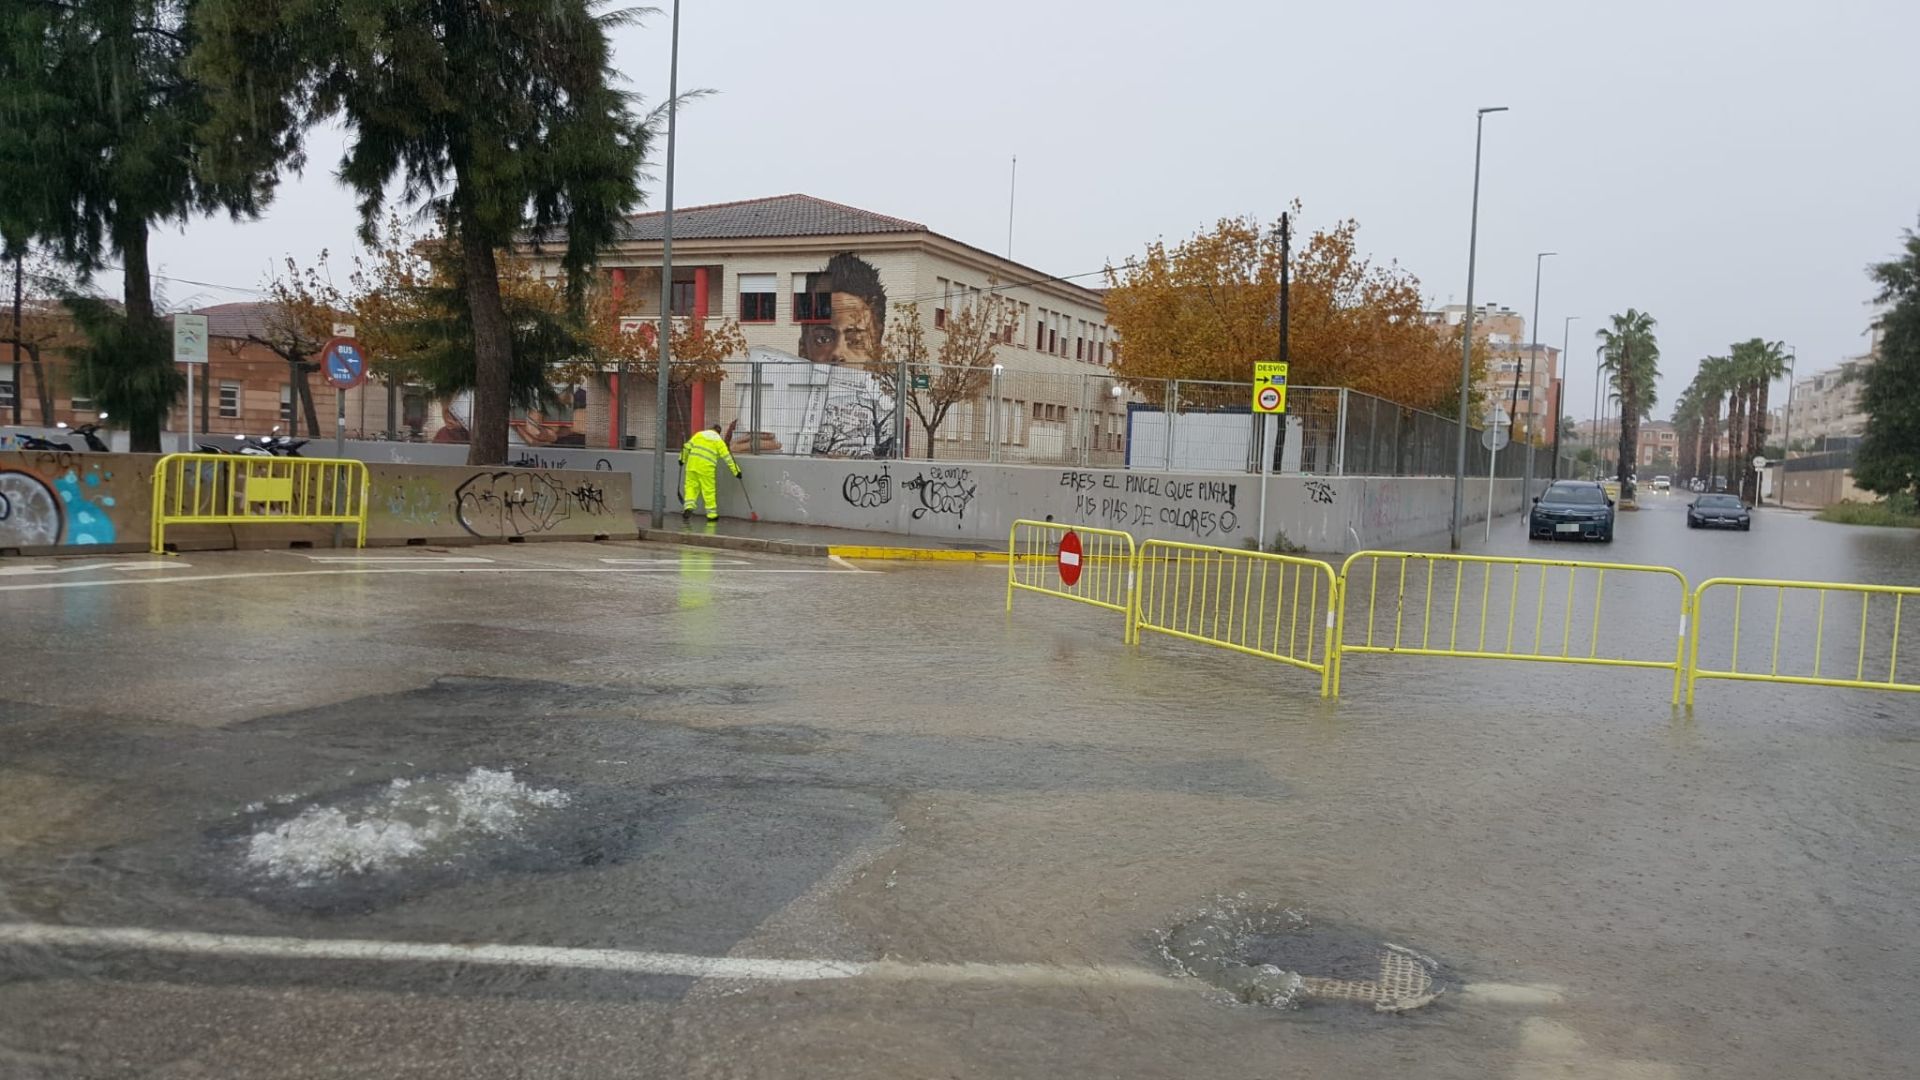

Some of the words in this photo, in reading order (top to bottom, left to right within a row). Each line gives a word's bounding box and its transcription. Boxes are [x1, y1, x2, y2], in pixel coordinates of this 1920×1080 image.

[338, 345, 353, 354] BUS
[1257, 364, 1286, 372] DESVIO
[1060, 471, 1096, 492] ERES
[1102, 474, 1119, 489] EL
[1125, 475, 1162, 497] PINCEL
[1165, 480, 1194, 501] QUE
[1075, 495, 1097, 520] MIS
[1131, 504, 1154, 526] DE
[1160, 507, 1217, 537] COLORES
